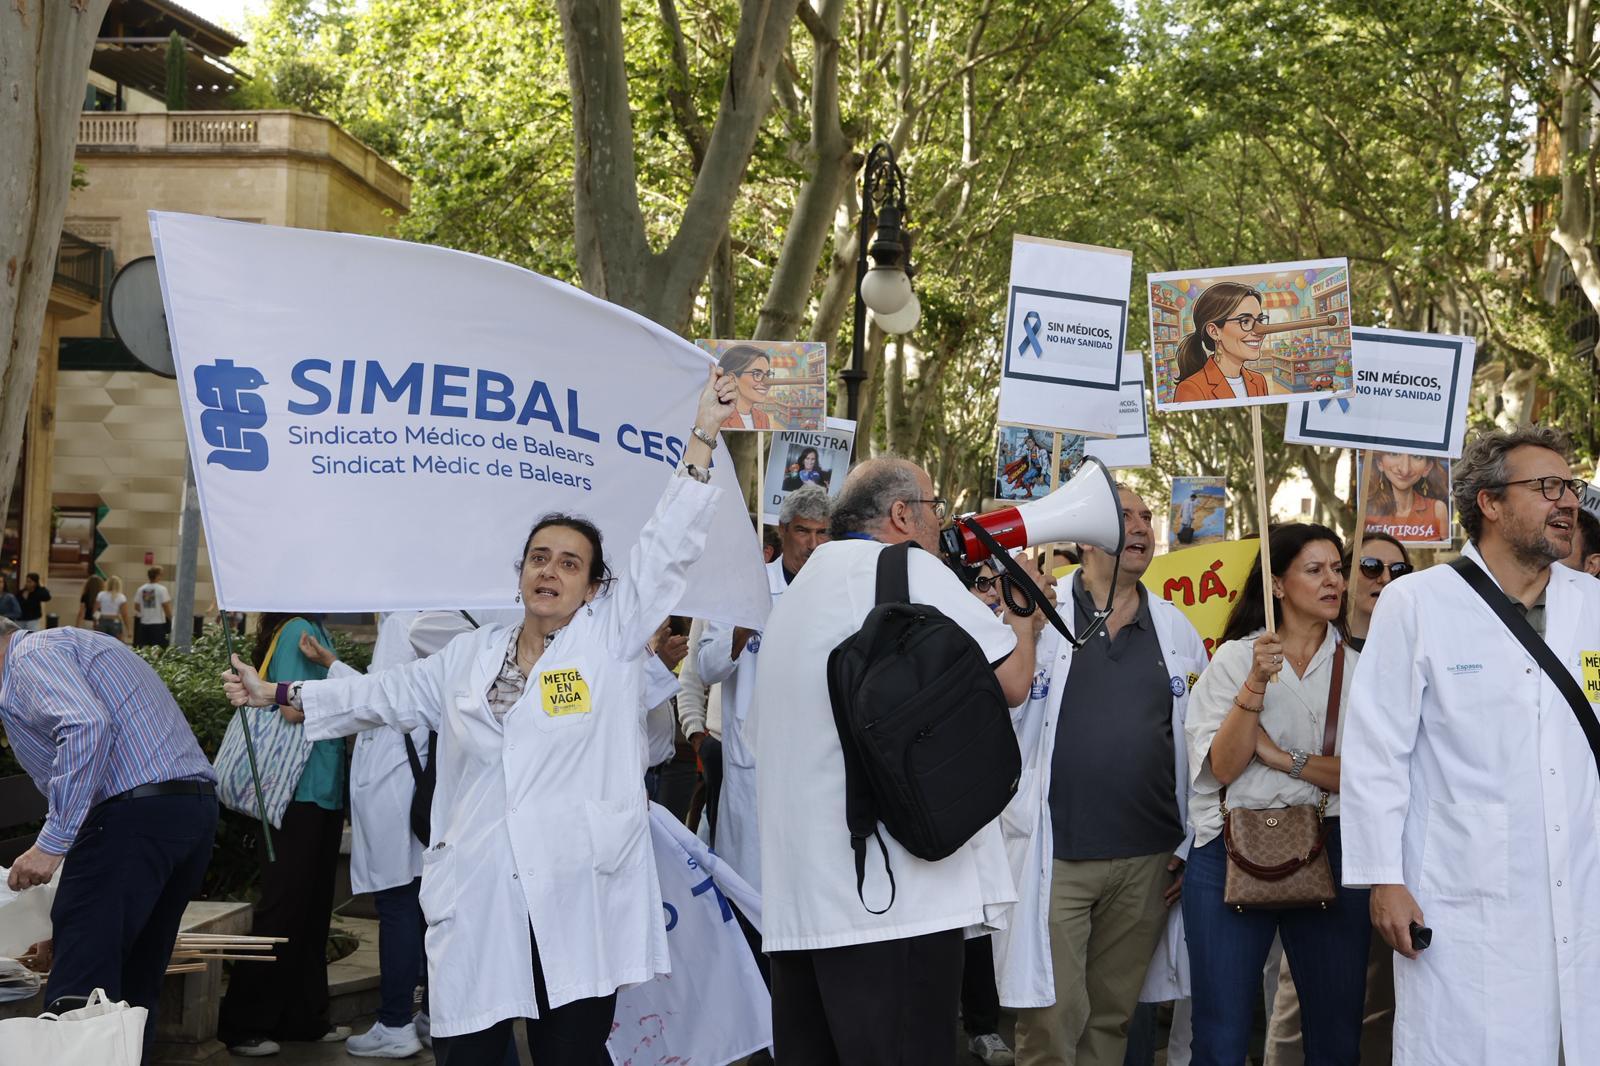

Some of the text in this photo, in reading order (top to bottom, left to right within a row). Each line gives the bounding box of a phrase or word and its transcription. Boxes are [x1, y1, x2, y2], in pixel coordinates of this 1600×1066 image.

[1047, 322, 1112, 340] SIN MÉDICOS,
[1046, 334, 1113, 350] NO HAY SANIDAD
[1357, 370, 1441, 390] SIN MÉDICOS,
[288, 358, 600, 443] SIMEBAL
[1355, 385, 1442, 402] NO HAY SANIDAD
[288, 425, 595, 467] Sindicato Médico de Balears
[617, 423, 715, 471] CES
[780, 431, 849, 452] MINISTRA
[312, 455, 592, 491] Sindicat Mèdic de Balears
[543, 671, 583, 685] METGE
[556, 682, 573, 693] EN
[550, 691, 582, 705] VAGA
